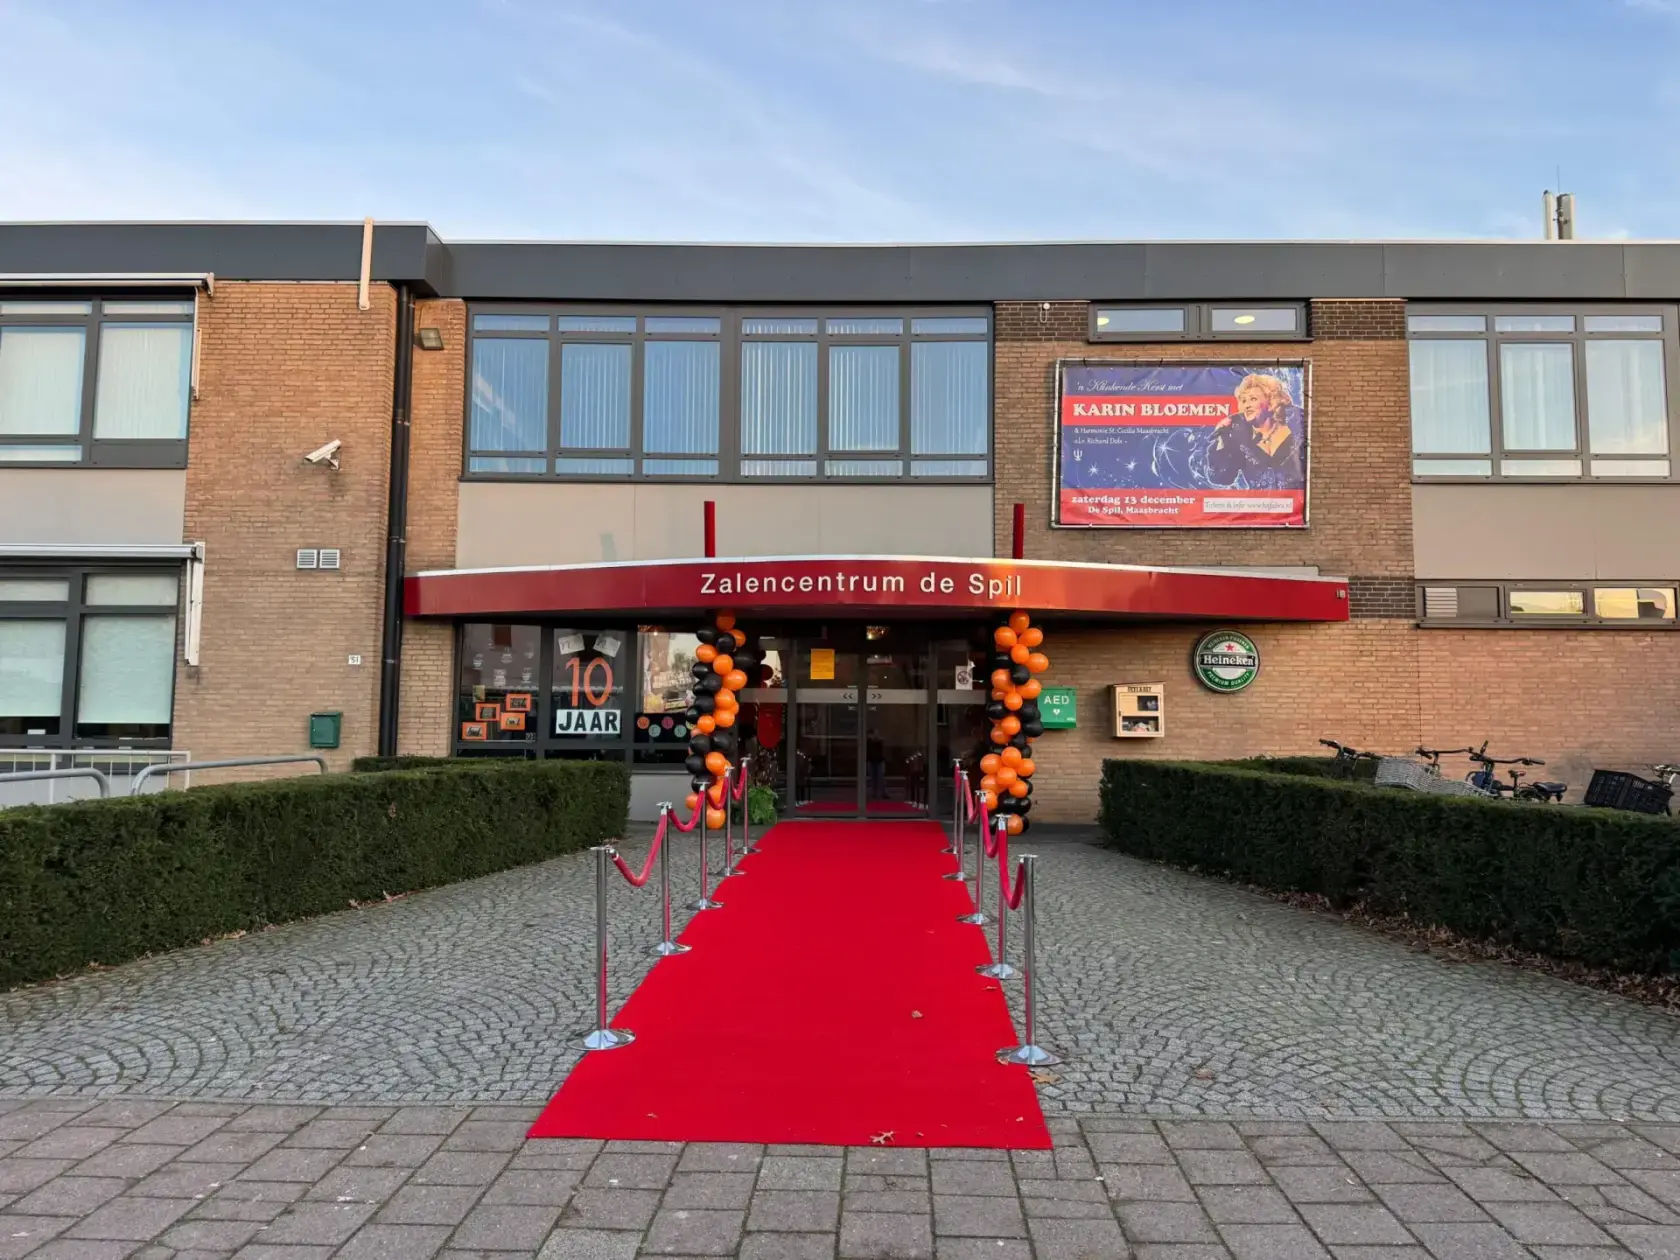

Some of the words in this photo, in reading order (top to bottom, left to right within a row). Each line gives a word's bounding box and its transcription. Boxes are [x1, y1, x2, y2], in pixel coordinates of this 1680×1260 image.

[1073, 403, 1136, 416] KARIN
[1141, 403, 1230, 416] BLOEMEN
[1072, 495, 1120, 505] zaterdag
[1124, 497, 1137, 505] 13
[1141, 495, 1195, 504] december
[1088, 506, 1100, 514] De
[1126, 506, 1179, 514] Maasbracht
[700, 573, 904, 594] Zalencentrum
[920, 572, 954, 592] de
[968, 573, 1022, 599] Spil
[1203, 655, 1254, 666] Heineken
[564, 657, 613, 707] 10
[1043, 695, 1070, 705] AED
[558, 711, 618, 732] JAAR
